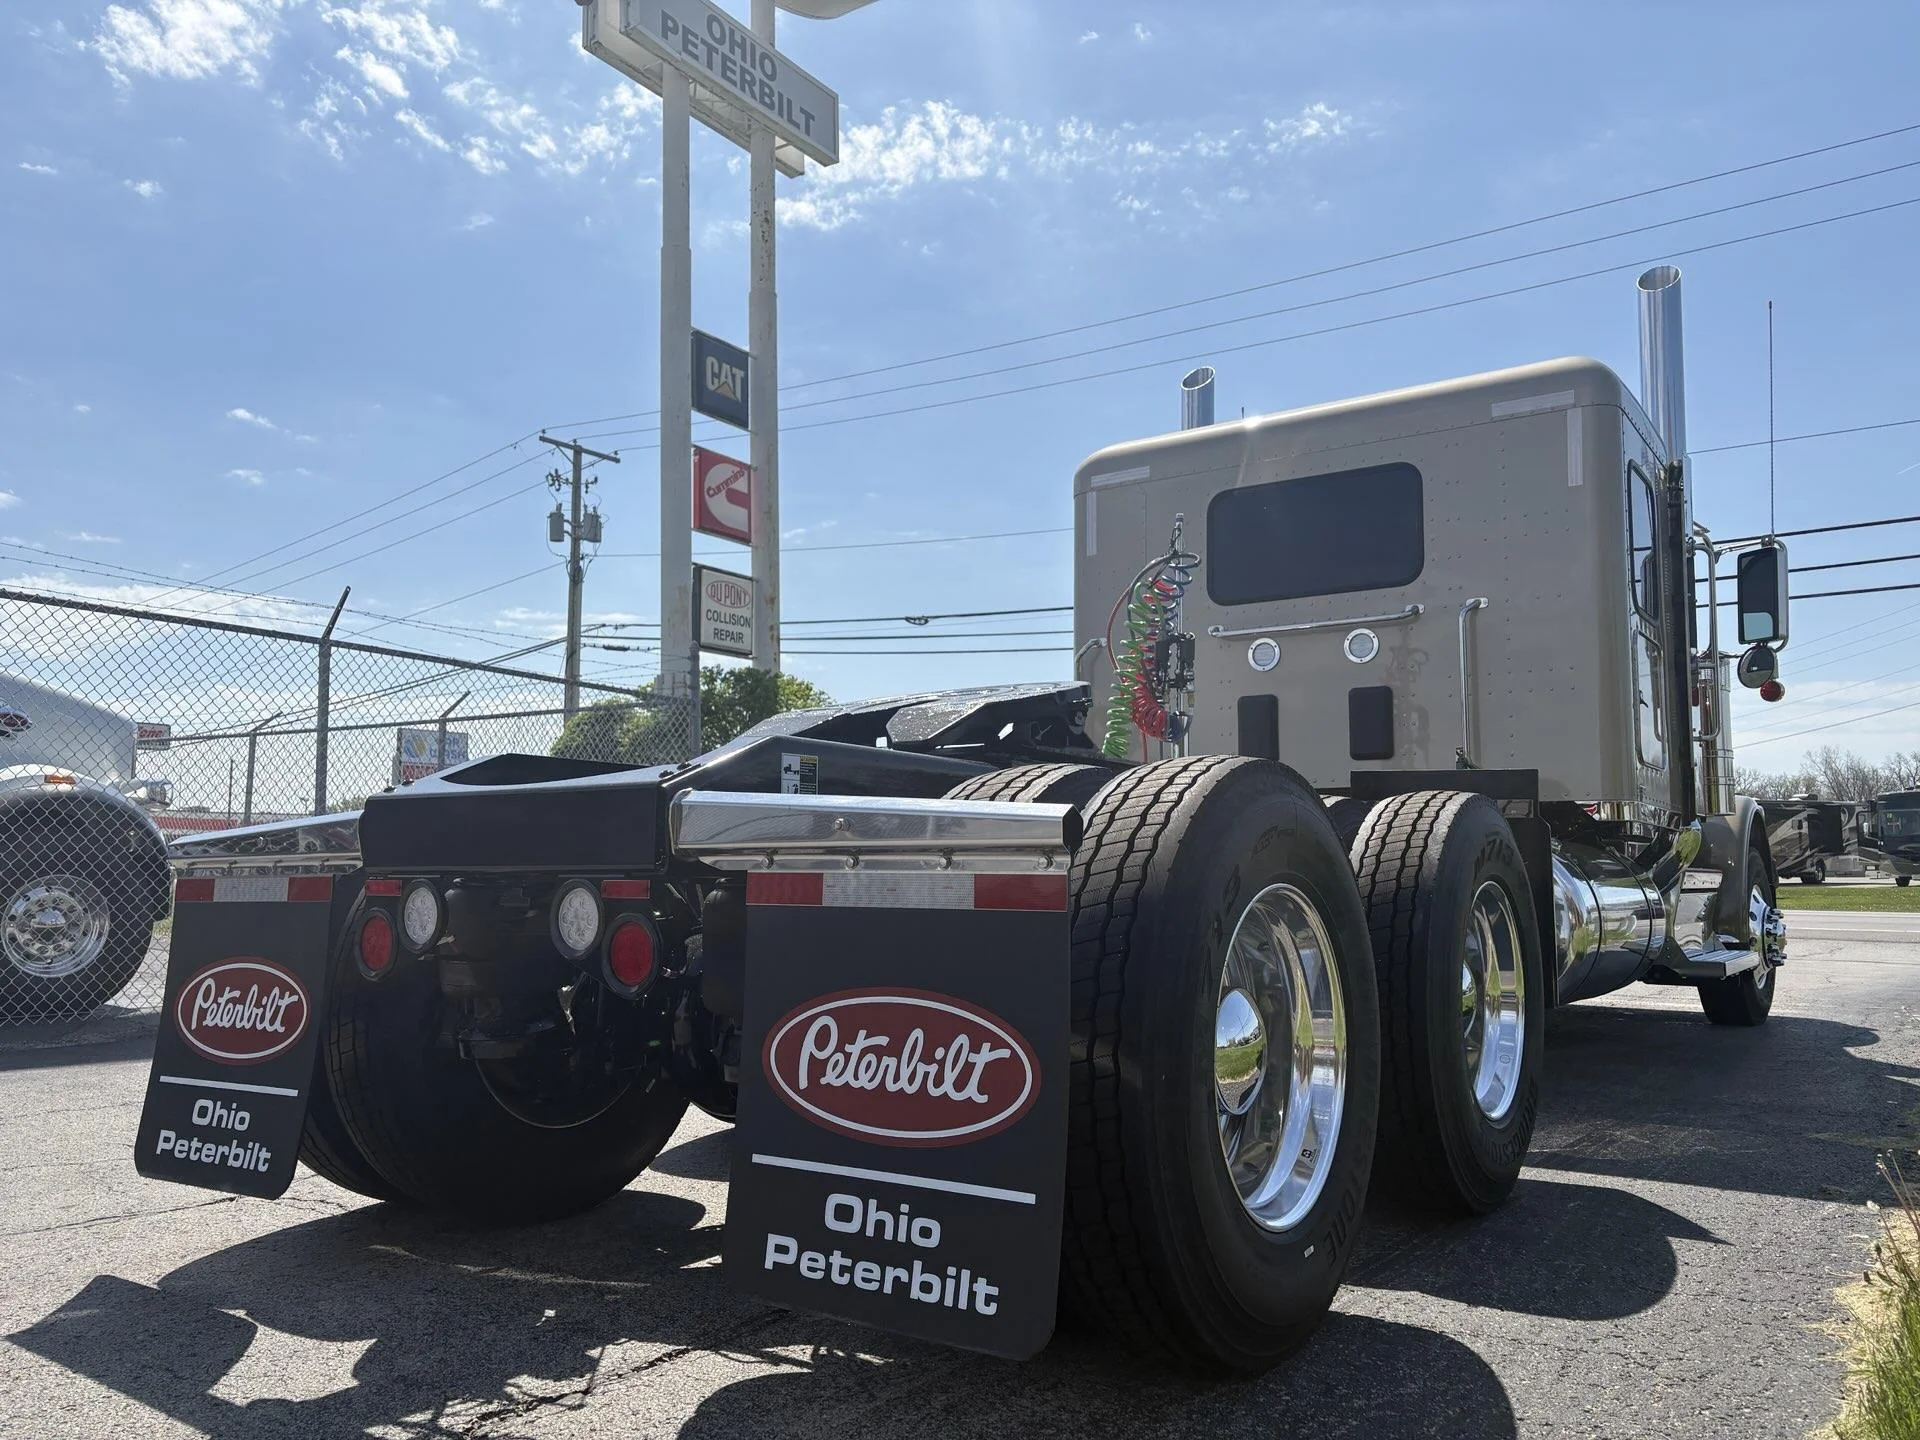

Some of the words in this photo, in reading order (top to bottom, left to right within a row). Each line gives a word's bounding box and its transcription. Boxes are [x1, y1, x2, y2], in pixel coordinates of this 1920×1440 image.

[660, 9, 816, 137] PETERBILT
[706, 13, 778, 82] OHIO
[706, 355, 745, 403] CAT
[706, 468, 745, 498] Cummins
[706, 609, 751, 628] COLLISION
[713, 627, 744, 644] REPAIR
[191, 977, 298, 1033] Peterbilt
[798, 1015, 1011, 1103] Peterbilt
[191, 1099, 250, 1132] Ohio
[156, 1129, 271, 1172] Peterbilt
[824, 1193, 941, 1248] Ohio
[764, 1233, 999, 1316] Peterbilt
